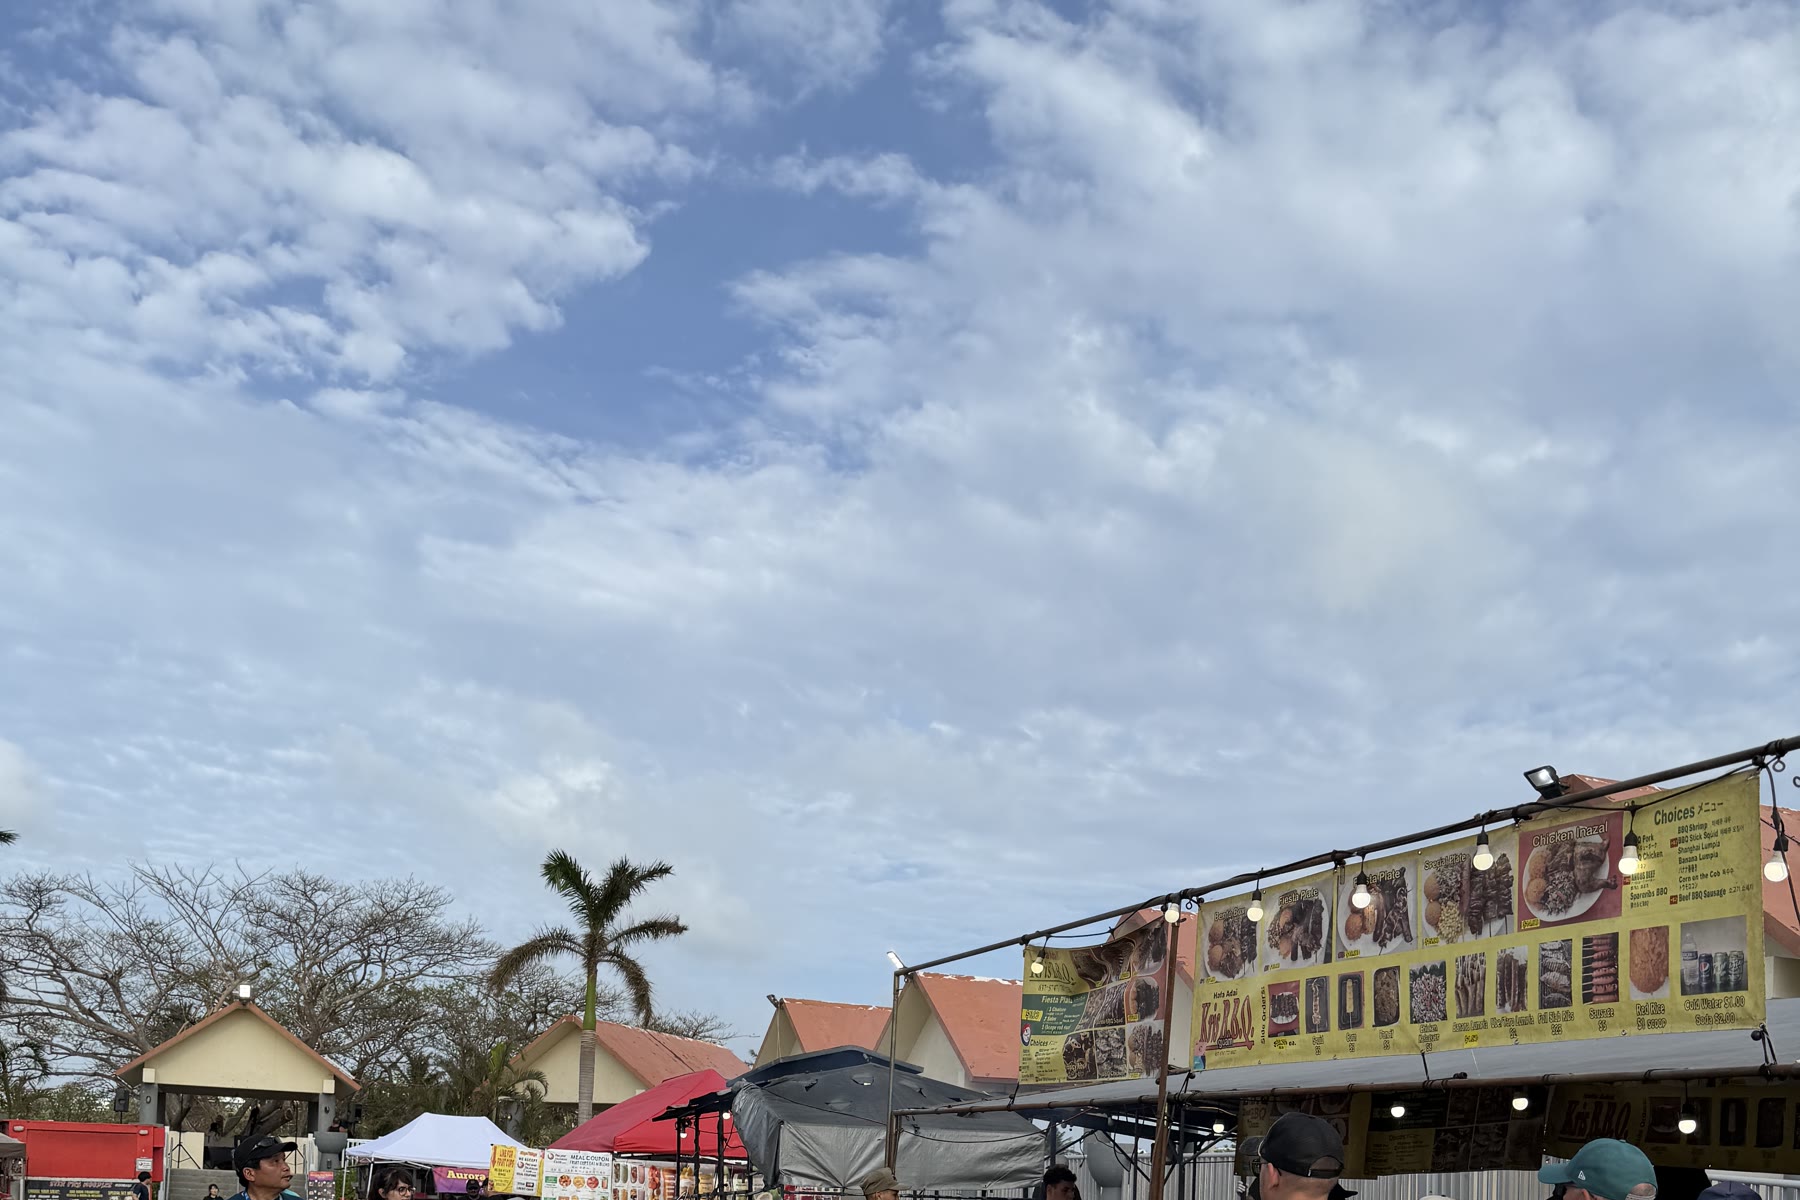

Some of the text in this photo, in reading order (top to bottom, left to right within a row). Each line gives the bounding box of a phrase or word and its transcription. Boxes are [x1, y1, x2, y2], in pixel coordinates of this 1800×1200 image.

[1654, 807, 1695, 825] Choices
[1532, 820, 1608, 848] Chicken Inazal
[1678, 822, 1708, 835] BBQ Shrimp
[1703, 830, 1719, 841] Squid
[1678, 840, 1720, 855] Shanghai Lumpia
[1424, 853, 1467, 870] Special Plate
[1643, 850, 1664, 860] Chicken
[1678, 851, 1718, 864] Banana Lumpia
[1353, 868, 1401, 887] Fsta Plate
[1678, 874, 1691, 883] Corn
[1710, 870, 1720, 878] Cob
[1279, 887, 1320, 906] Fiesta Plate
[1656, 887, 1668, 896] BBQ
[1678, 887, 1726, 902] Beef BBQ Sausage
[1214, 907, 1246, 921] Bento Box
[1226, 988, 1238, 998] Adai
[1042, 996, 1058, 1004] Fiesta
[1684, 995, 1745, 1012] Cold Water $1.00
[1589, 1008, 1614, 1020] Sausage
[1636, 1002, 1666, 1016] Red Rice
[1548, 1011, 1561, 1022] Slab
[1562, 1010, 1574, 1022] Ribs
[1695, 1012, 1736, 1026] Soda $2.00
[1636, 1018, 1667, 1030] $1 scoop
[447, 1170, 486, 1181] Aurora
